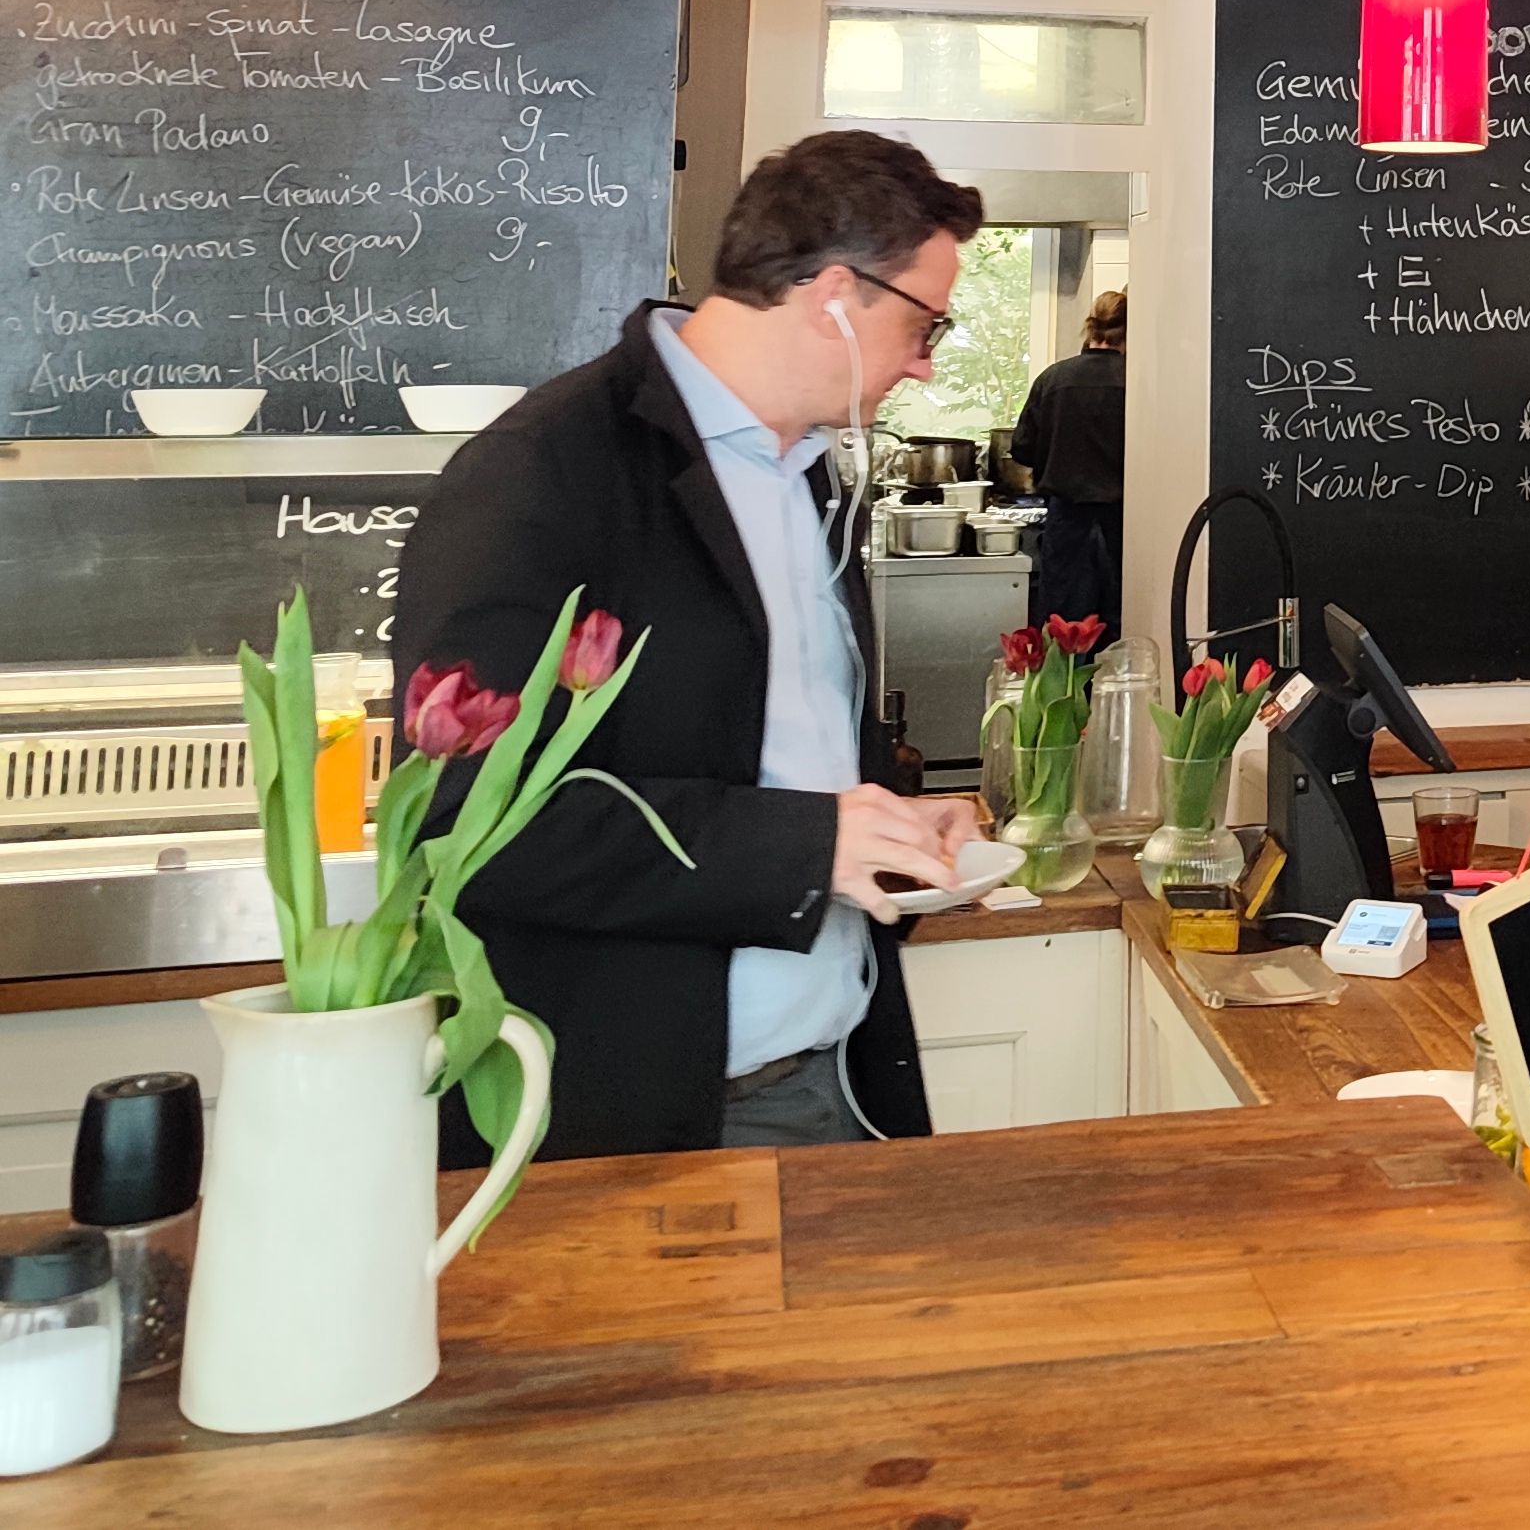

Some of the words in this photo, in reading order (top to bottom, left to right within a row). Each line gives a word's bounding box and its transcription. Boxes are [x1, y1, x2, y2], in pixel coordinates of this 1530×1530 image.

[35, 50, 227, 111] getrocknete
[236, 49, 371, 90] Tomaten
[134, 108, 270, 152] Padano
[27, 164, 105, 214] Rote
[1262, 153, 1340, 200] Rote
[1355, 154, 1447, 194] Linsen
[25, 231, 258, 290] Champignons
[280, 209, 423, 282] (vegan)
[1398, 255, 1432, 288] Ei
[31, 290, 204, 336] Moussaka
[1246, 345, 1360, 409] Dips
[1284, 401, 1411, 443] Grünes
[1410, 397, 1501, 445] Pesto
[277, 494, 419, 548] Hausg
